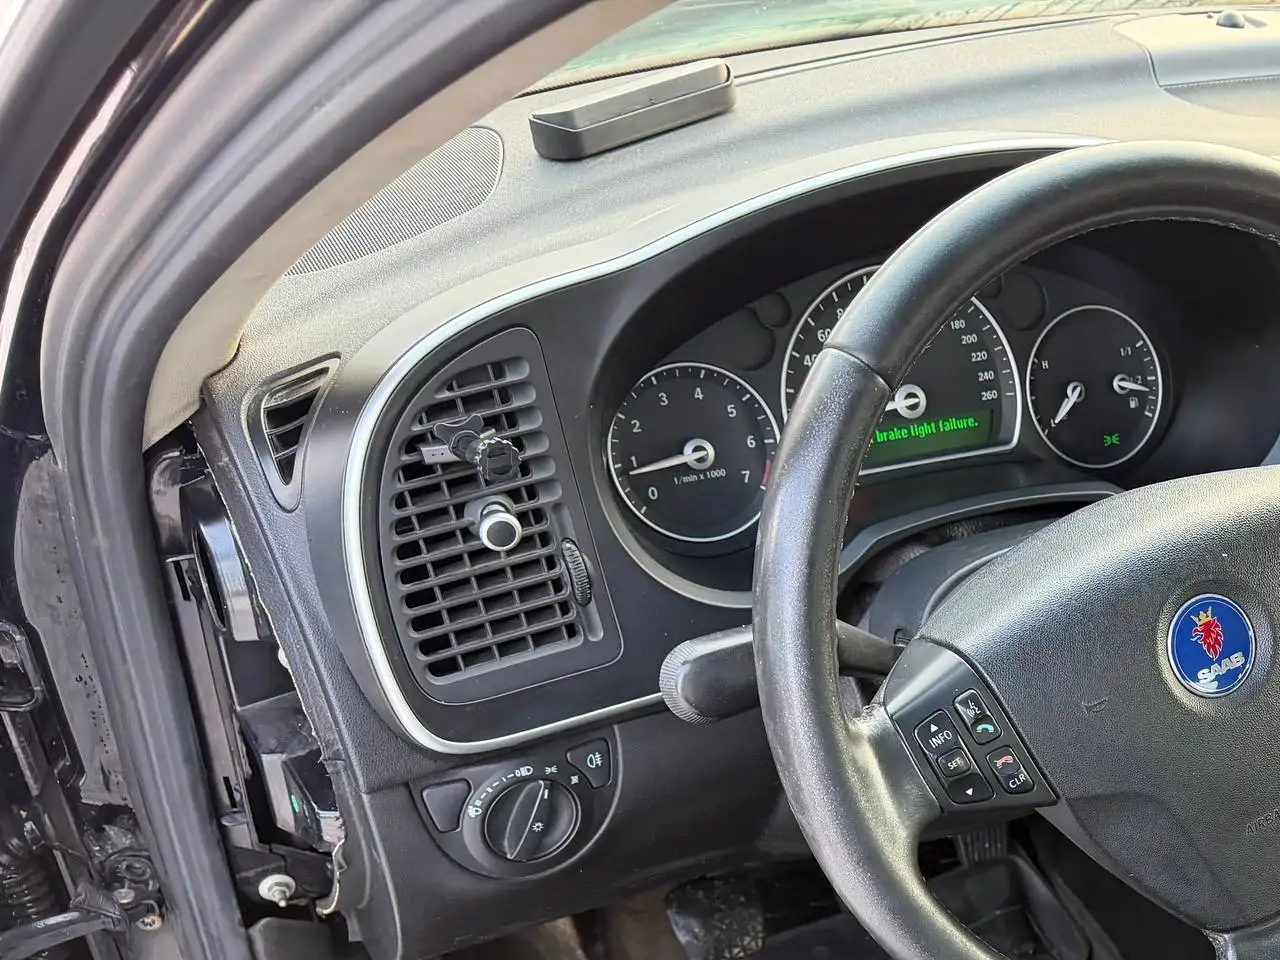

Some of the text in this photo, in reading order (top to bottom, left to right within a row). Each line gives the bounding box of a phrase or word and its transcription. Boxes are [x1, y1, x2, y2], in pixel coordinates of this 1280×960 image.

[950, 319, 965, 330] 180
[961, 333, 977, 345] 200
[971, 351, 988, 362] 220
[1042, 360, 1048, 369] H
[978, 370, 994, 381] 240
[658, 392, 669, 406] 3
[694, 387, 704, 401] 4
[981, 390, 998, 401] 260
[727, 404, 737, 417] 5
[631, 419, 642, 433] 2
[876, 417, 979, 443] brake light failure.
[746, 435, 756, 448] 6
[630, 455, 638, 468] 1
[673, 474, 698, 485] 1/min
[706, 468, 726, 479] 1000
[741, 470, 750, 483] 7
[648, 486, 658, 500] 0
[1197, 651, 1245, 684] SAAB
[928, 729, 953, 749] INFO
[947, 757, 962, 770] SET
[1009, 773, 1027, 788] CLR
